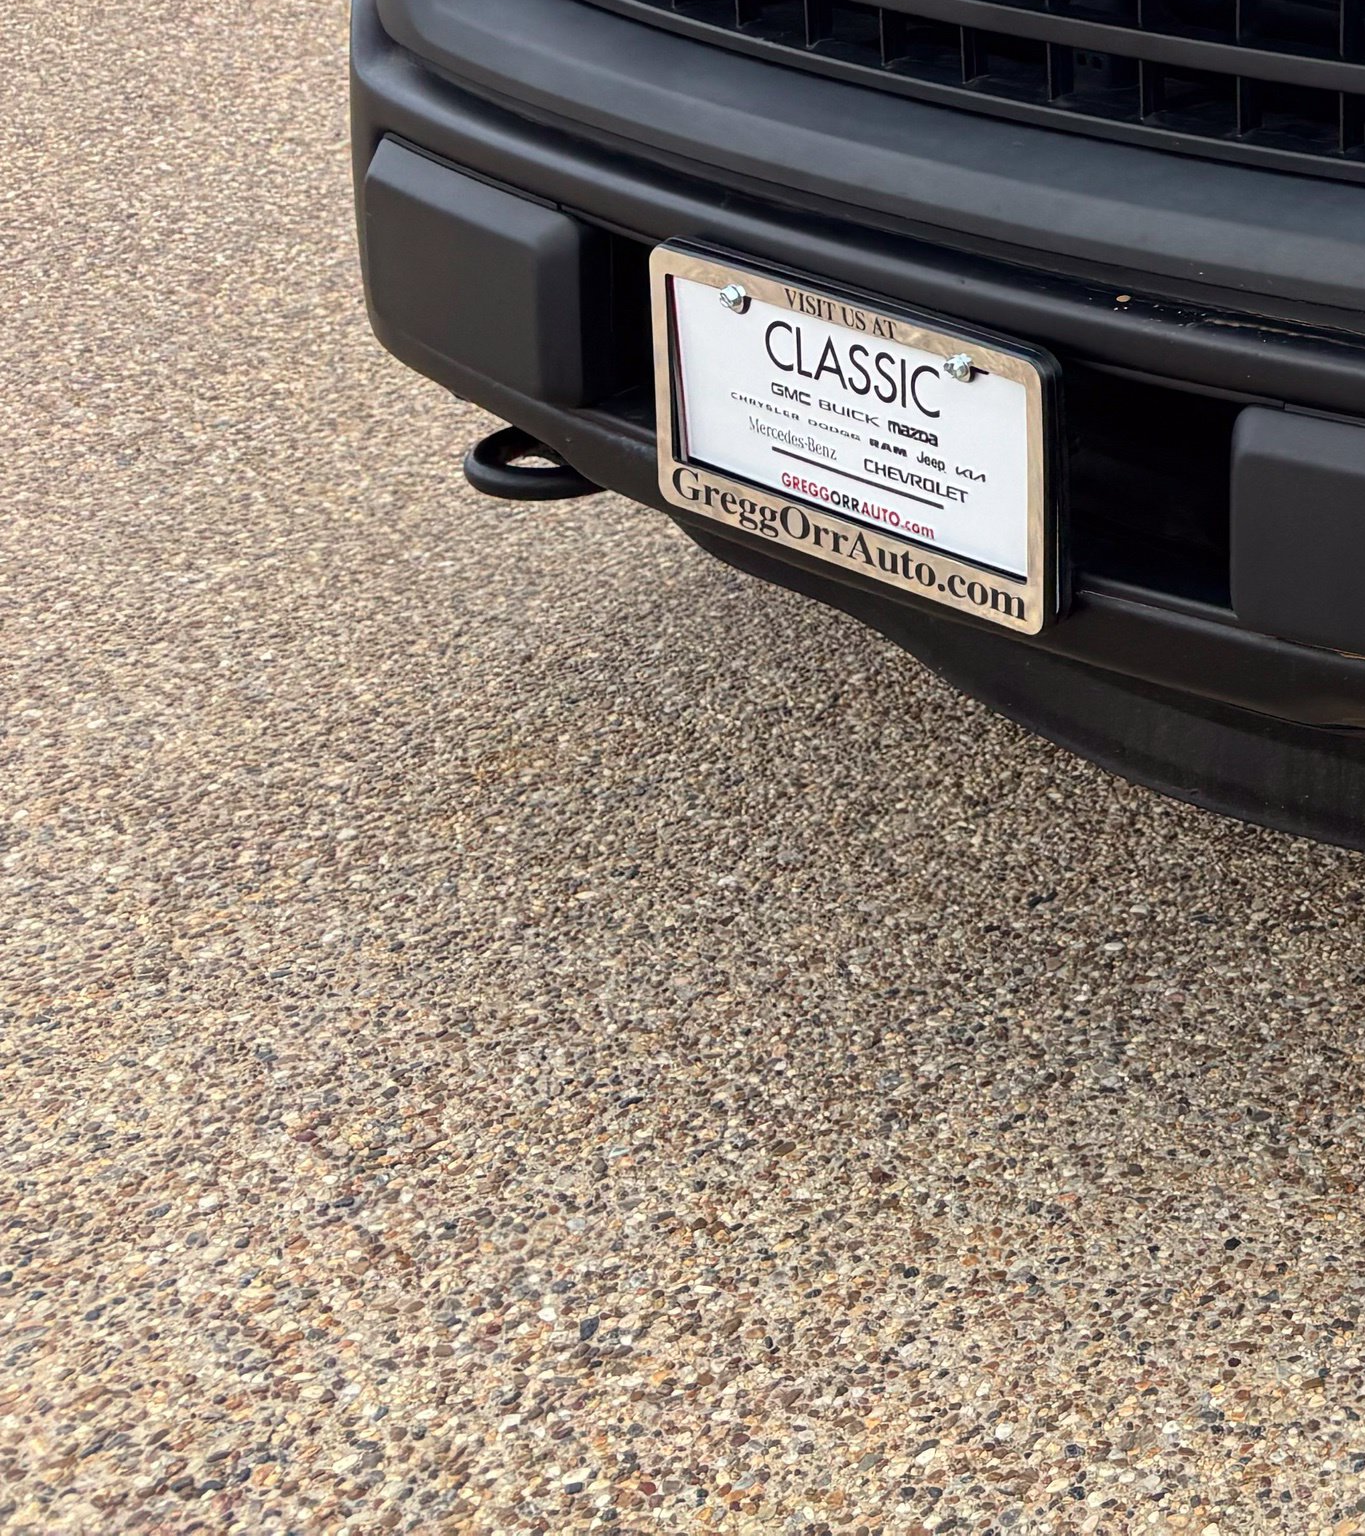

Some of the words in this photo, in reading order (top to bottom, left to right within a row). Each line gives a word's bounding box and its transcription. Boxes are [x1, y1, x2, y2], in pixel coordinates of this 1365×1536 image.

[784, 287, 836, 321] VISIT
[841, 306, 866, 332] US
[872, 316, 897, 340] AT
[764, 320, 941, 419] CLASSIC
[771, 381, 812, 406] GMC
[818, 399, 881, 428] BUICK
[730, 391, 800, 421] CHRYSLER
[807, 418, 861, 442] DODGE
[869, 438, 908, 458] RAM
[916, 451, 946, 473] Jeep
[748, 415, 838, 461] Mercedes-Benz
[863, 458, 969, 504] CHEVROLET
[671, 466, 1027, 623] GreggOrrAuto.com
[780, 472, 936, 541] GREGGORRAUTO.com
